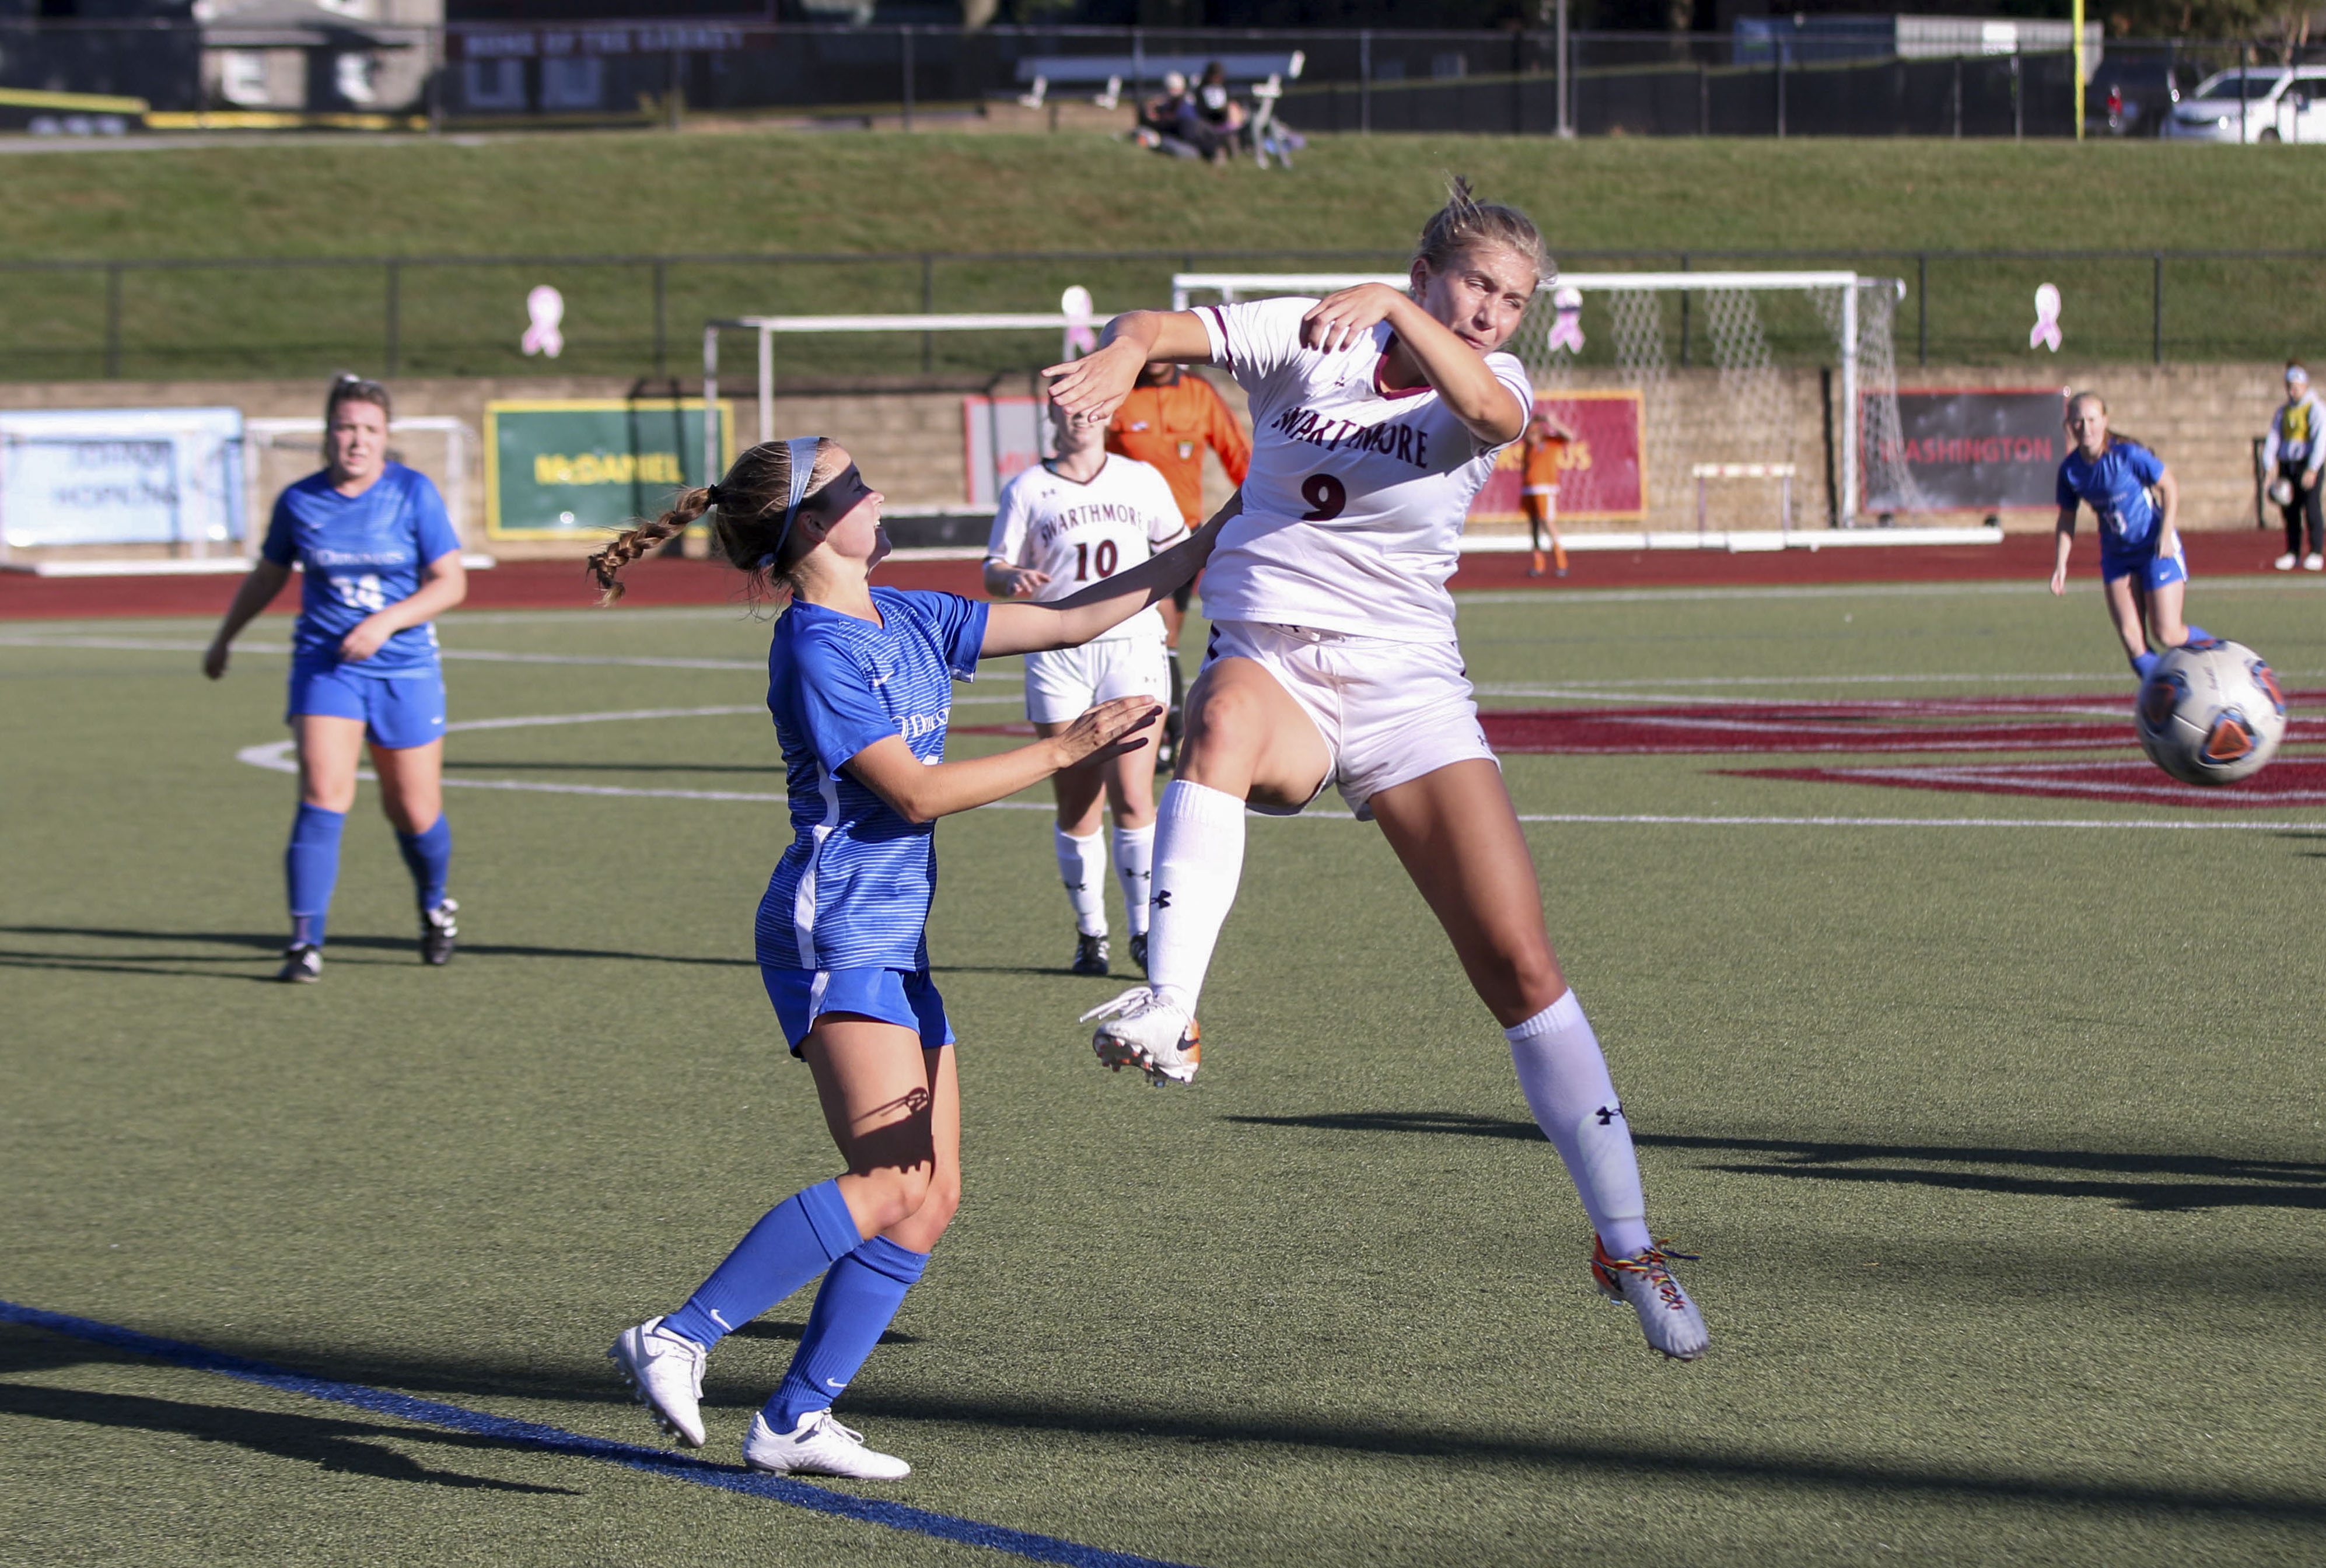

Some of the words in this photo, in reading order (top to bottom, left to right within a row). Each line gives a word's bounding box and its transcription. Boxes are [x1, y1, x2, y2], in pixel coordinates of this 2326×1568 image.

[1301, 474, 1346, 521] 9
[1041, 503, 1143, 548] SWARTHMORE
[1074, 538, 1118, 581] 10
